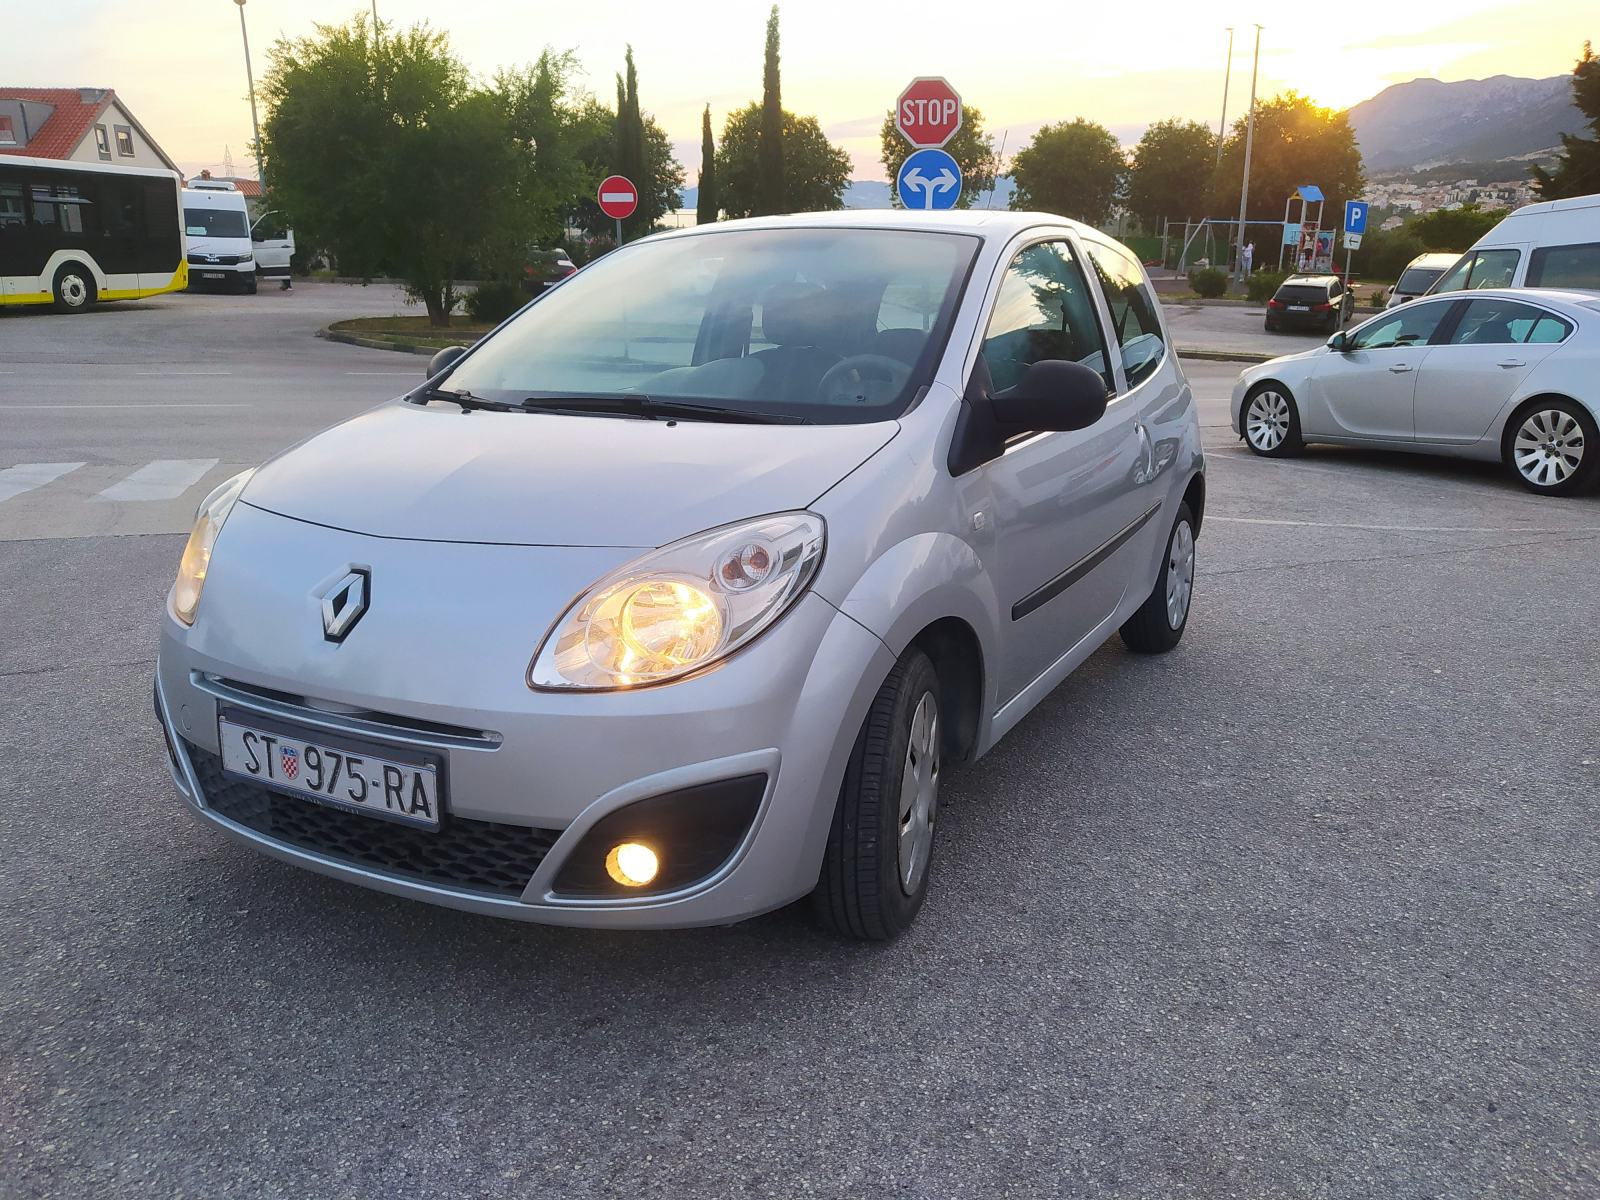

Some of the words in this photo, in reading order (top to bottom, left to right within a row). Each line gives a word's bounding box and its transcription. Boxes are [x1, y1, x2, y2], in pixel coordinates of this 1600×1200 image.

[902, 98, 957, 127] STOP
[1350, 207, 1362, 227] P
[241, 730, 278, 779] ST
[303, 745, 432, 819] 975-RA
